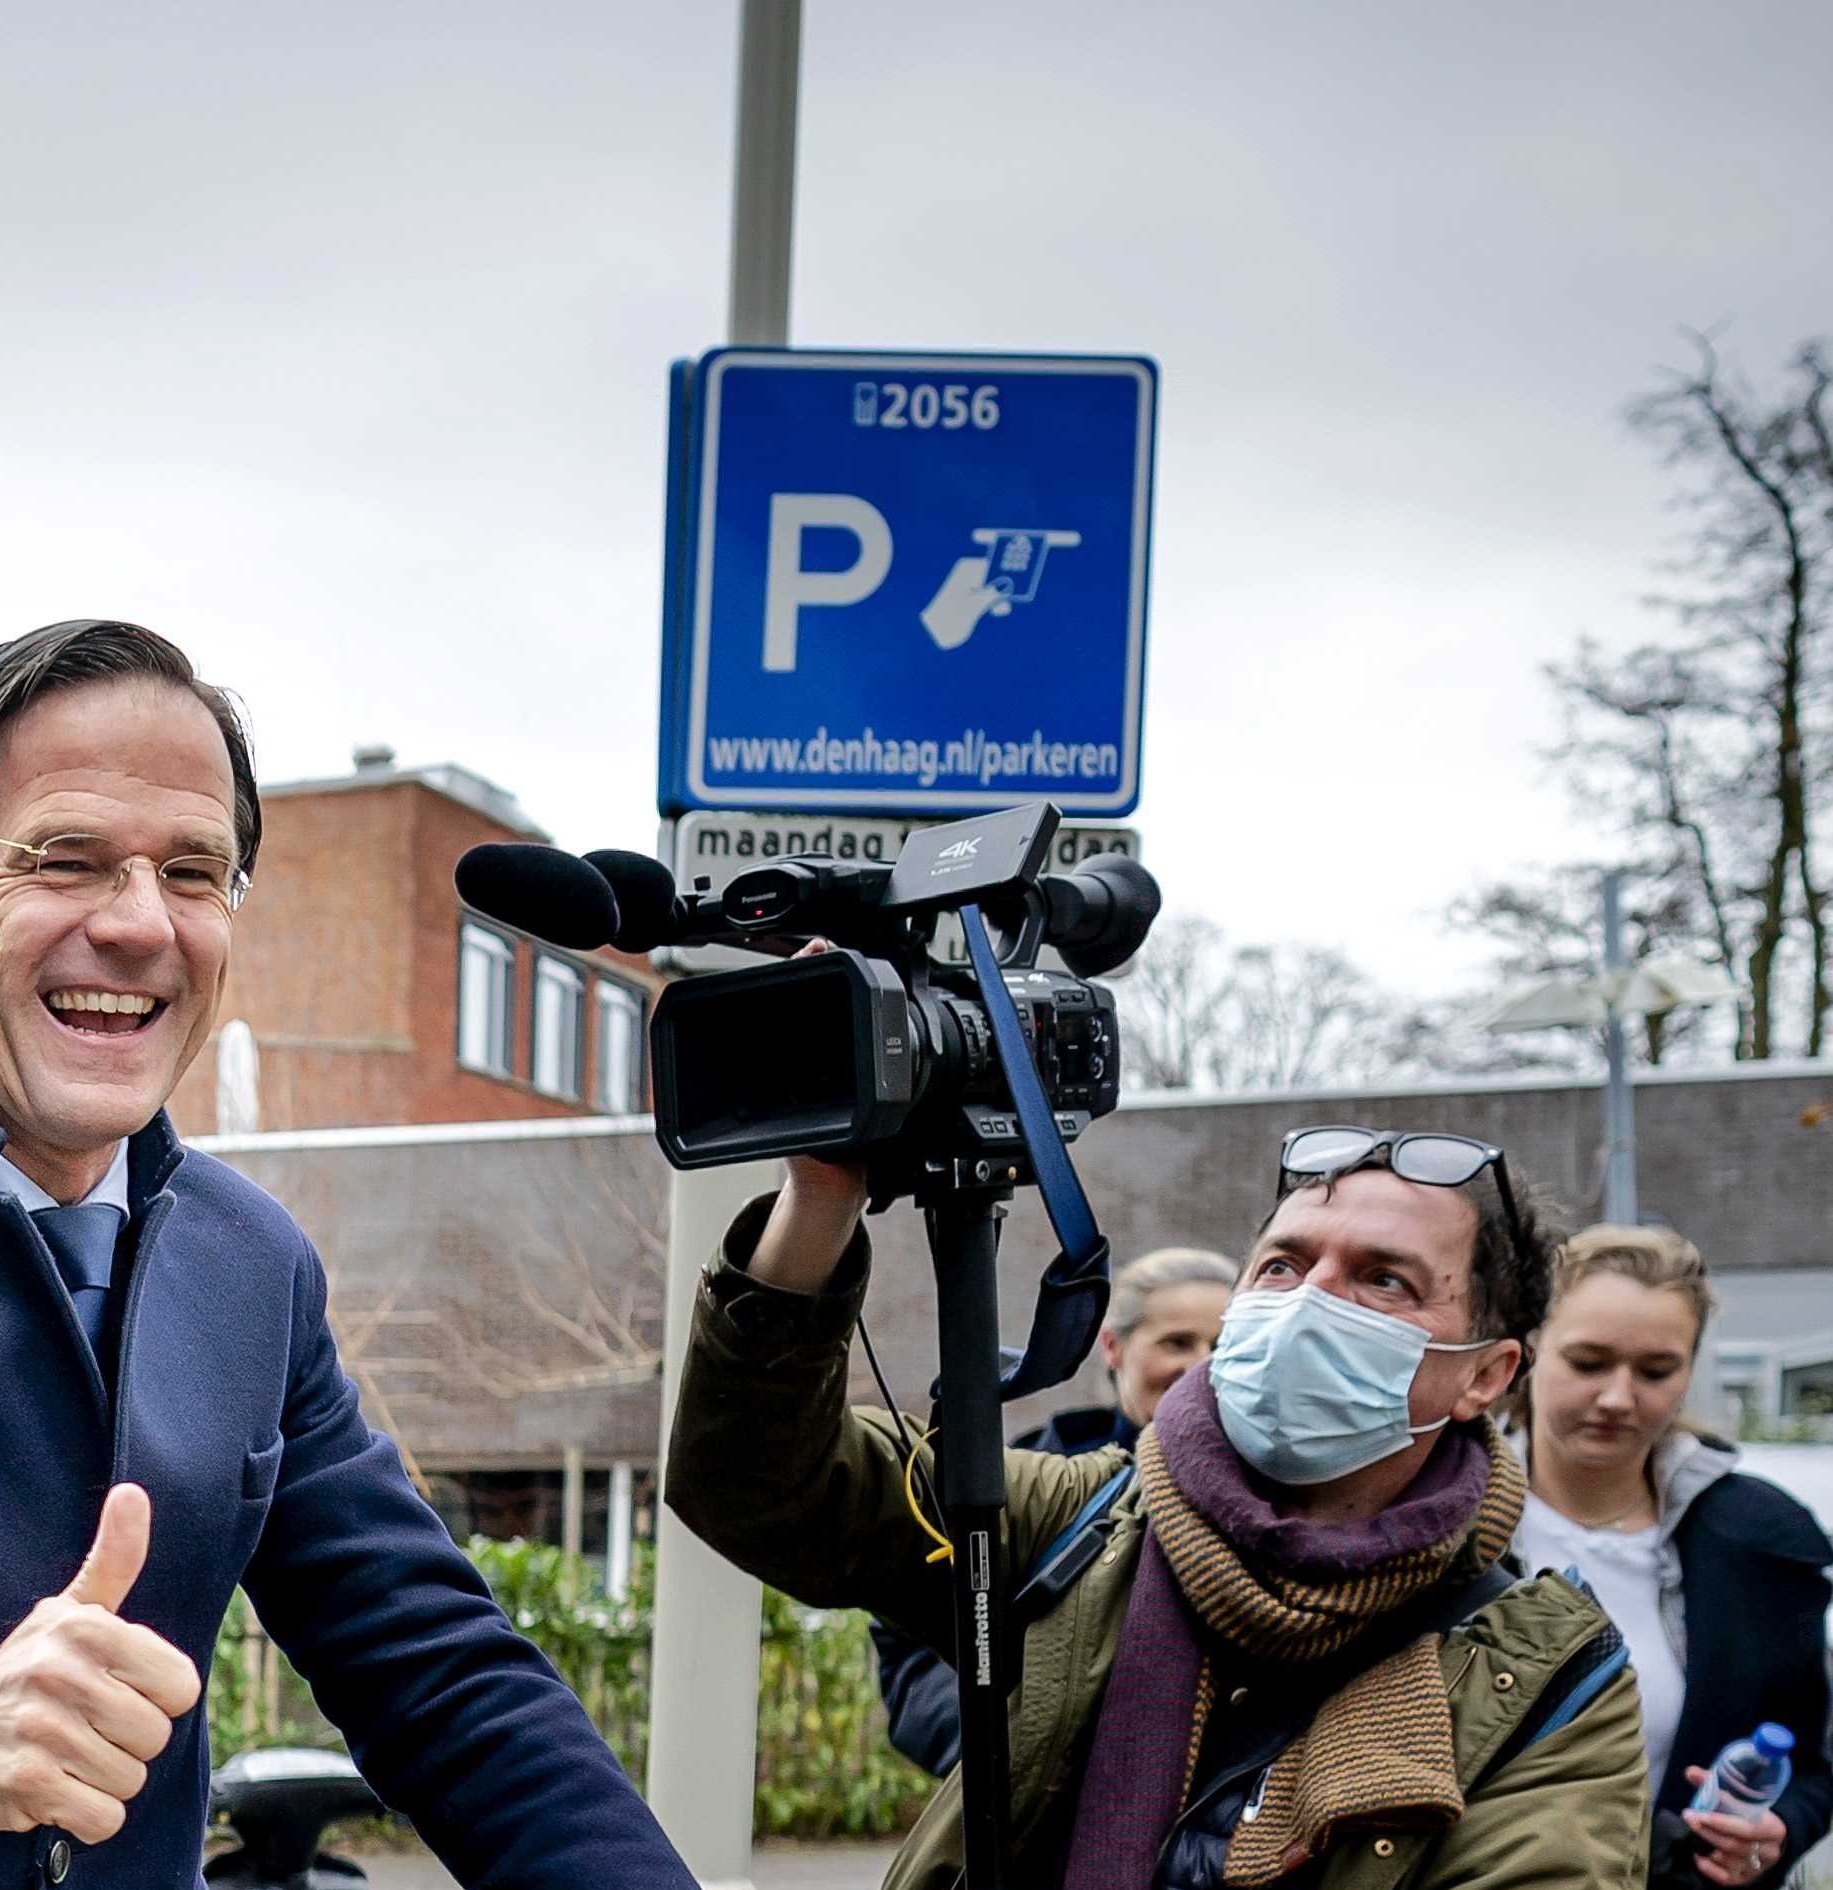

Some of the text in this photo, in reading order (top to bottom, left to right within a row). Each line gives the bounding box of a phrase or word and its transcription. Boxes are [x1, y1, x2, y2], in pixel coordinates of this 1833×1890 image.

[879, 383, 1000, 429] 2056
[763, 492, 893, 672] P
[709, 726, 1117, 786] www.denhaag.nl/parkeren
[939, 835, 983, 858] 4K
[974, 1591, 991, 1686] Manfrotto
